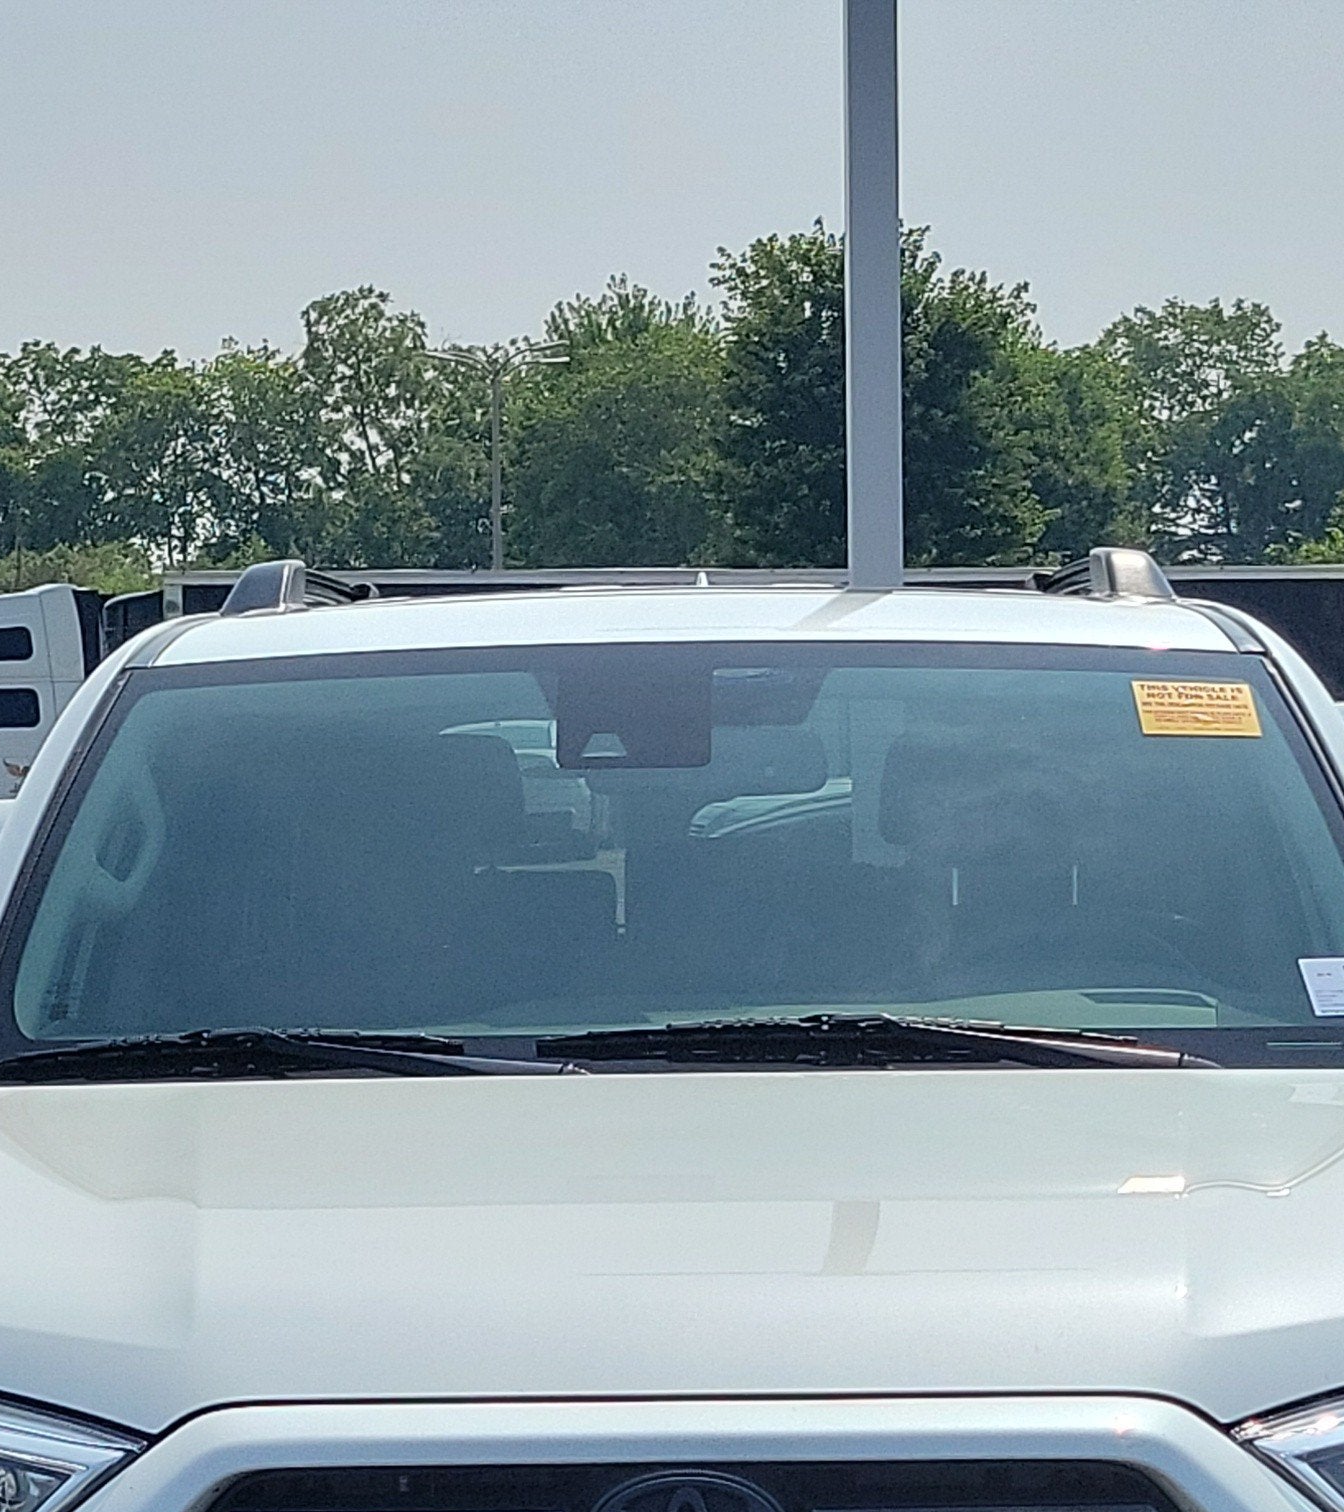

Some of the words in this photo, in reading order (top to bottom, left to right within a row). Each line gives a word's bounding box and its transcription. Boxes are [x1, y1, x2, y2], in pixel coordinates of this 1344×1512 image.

[1139, 684, 1169, 692] THIS
[1171, 684, 1227, 694] VEHICLE
[1230, 686, 1244, 694] IS
[1146, 692, 1173, 700] NOT
[1177, 692, 1204, 700] FOR
[1206, 693, 1239, 701] SALE
